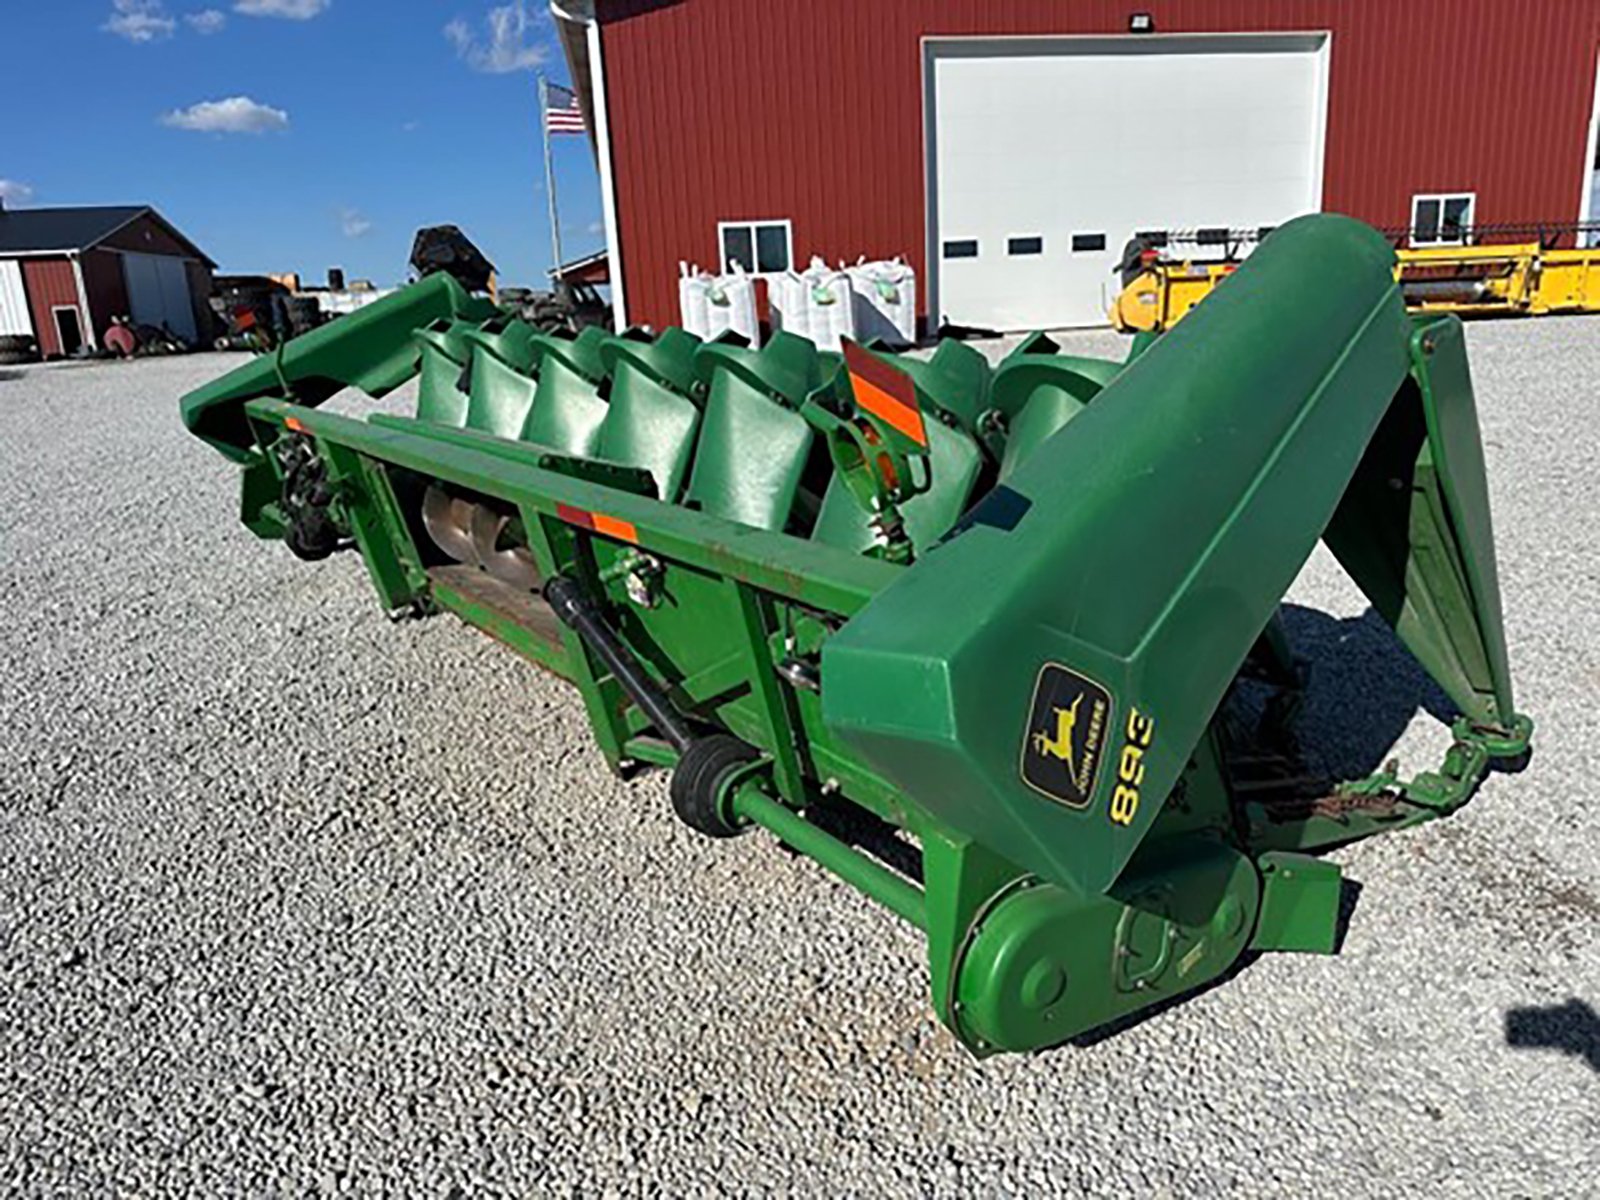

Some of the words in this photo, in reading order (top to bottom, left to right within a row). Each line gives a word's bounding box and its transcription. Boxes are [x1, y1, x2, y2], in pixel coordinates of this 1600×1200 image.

[1085, 700, 1105, 750] DEERE
[1078, 751, 1094, 795] JOHN
[1110, 706, 1154, 826] 893
